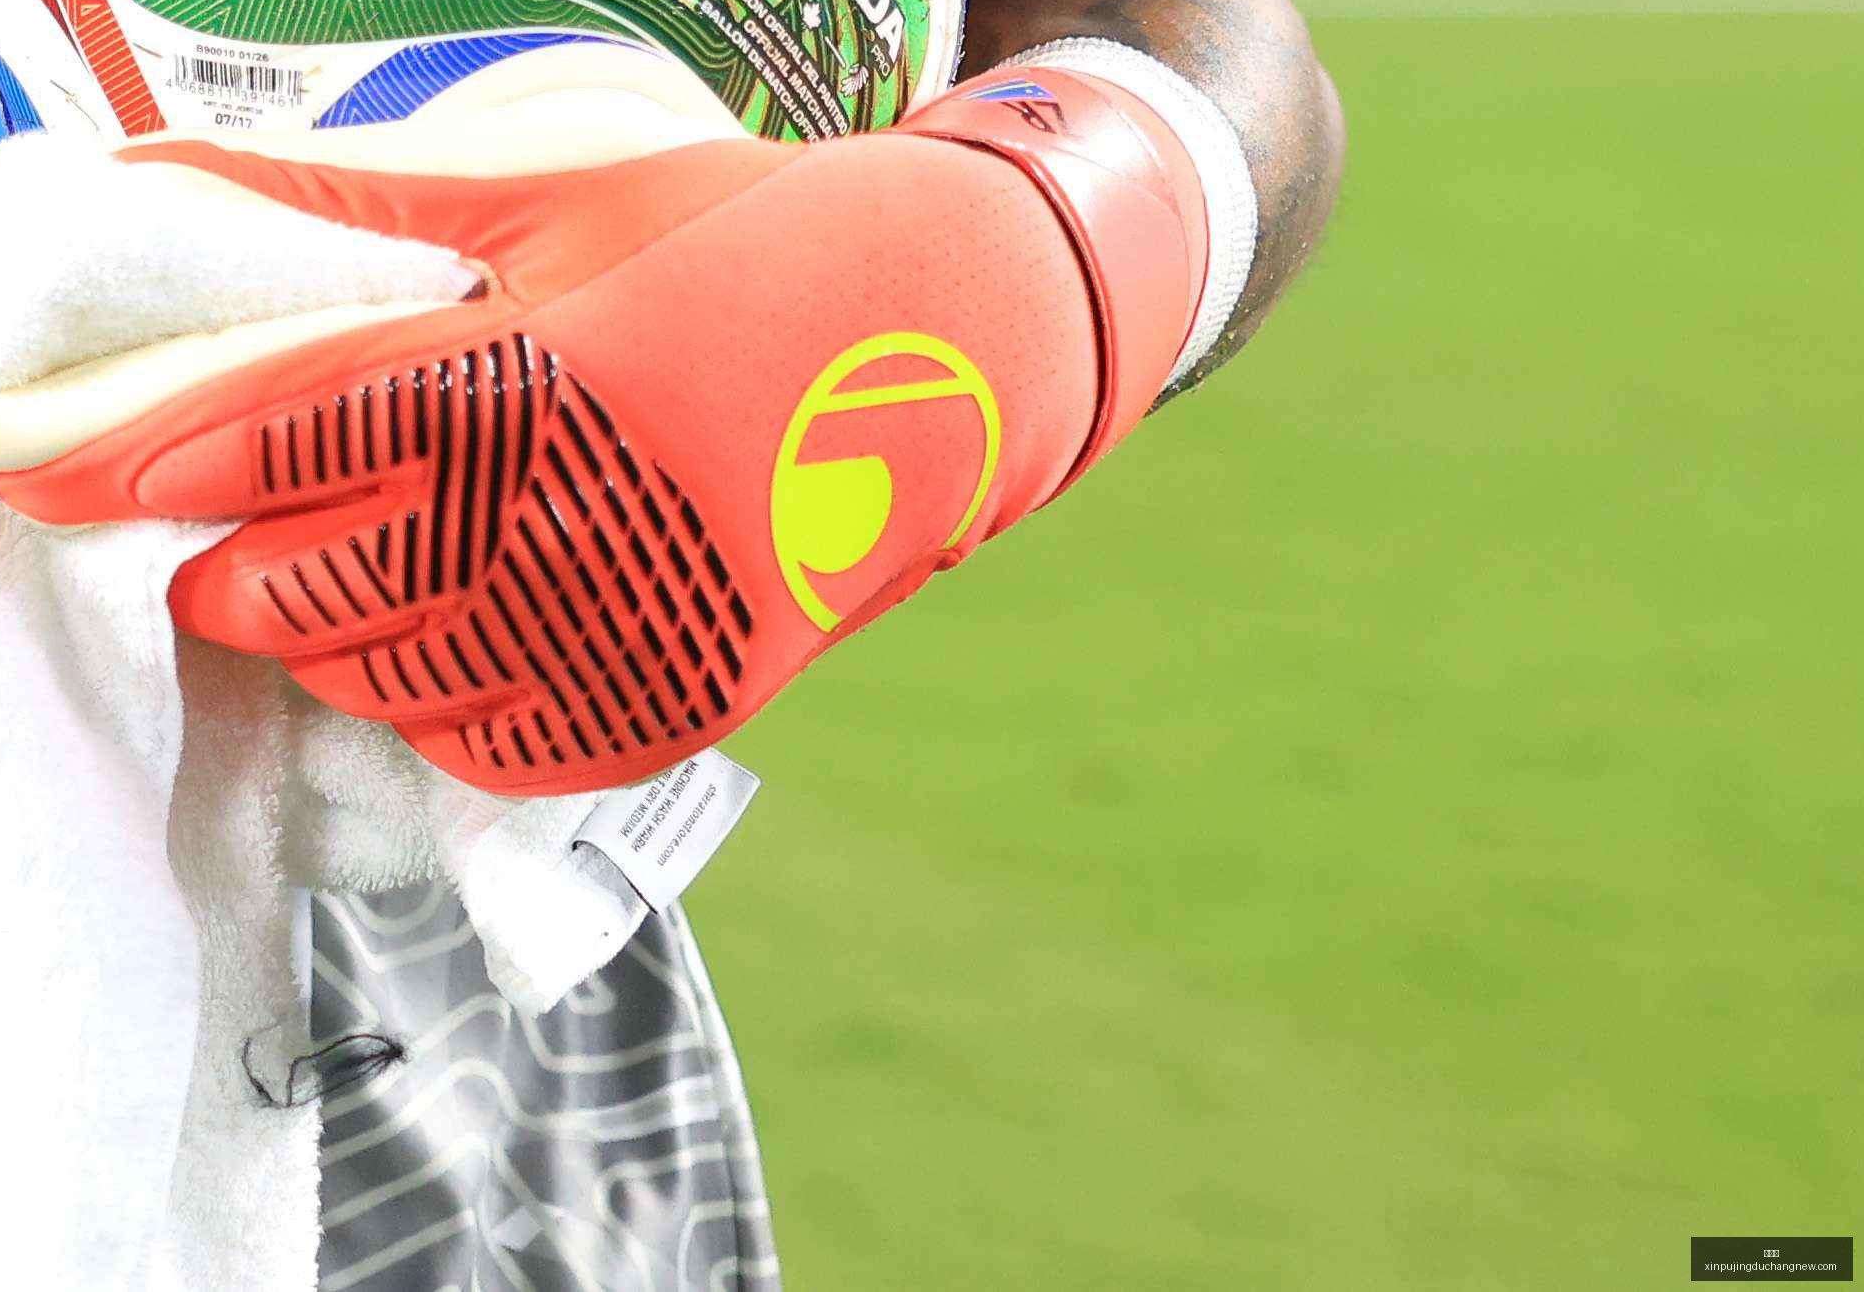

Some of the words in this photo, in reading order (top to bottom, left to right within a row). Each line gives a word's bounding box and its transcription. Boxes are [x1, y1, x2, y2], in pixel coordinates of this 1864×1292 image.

[196, 44, 235, 58] B90010
[239, 49, 270, 62] 01/26
[701, 0, 750, 55] BALLON
[748, 51, 764, 73] DE
[761, 67, 795, 112] MATCH
[743, 18, 790, 79] OFFICIAL
[787, 75, 822, 120] MATCH
[870, 44, 890, 77] PRO
[766, 15, 803, 65] OFICIAL
[801, 61, 820, 87] DEL
[817, 84, 847, 136] PARTIDO
[215, 113, 253, 129] 07/17
[648, 785, 661, 805] DRY
[671, 759, 699, 800] MACHINE
[620, 803, 649, 838] MEDIUM
[653, 796, 674, 827] WASH
[657, 784, 716, 866] sheratonstore.com
[631, 824, 657, 853] WARM
